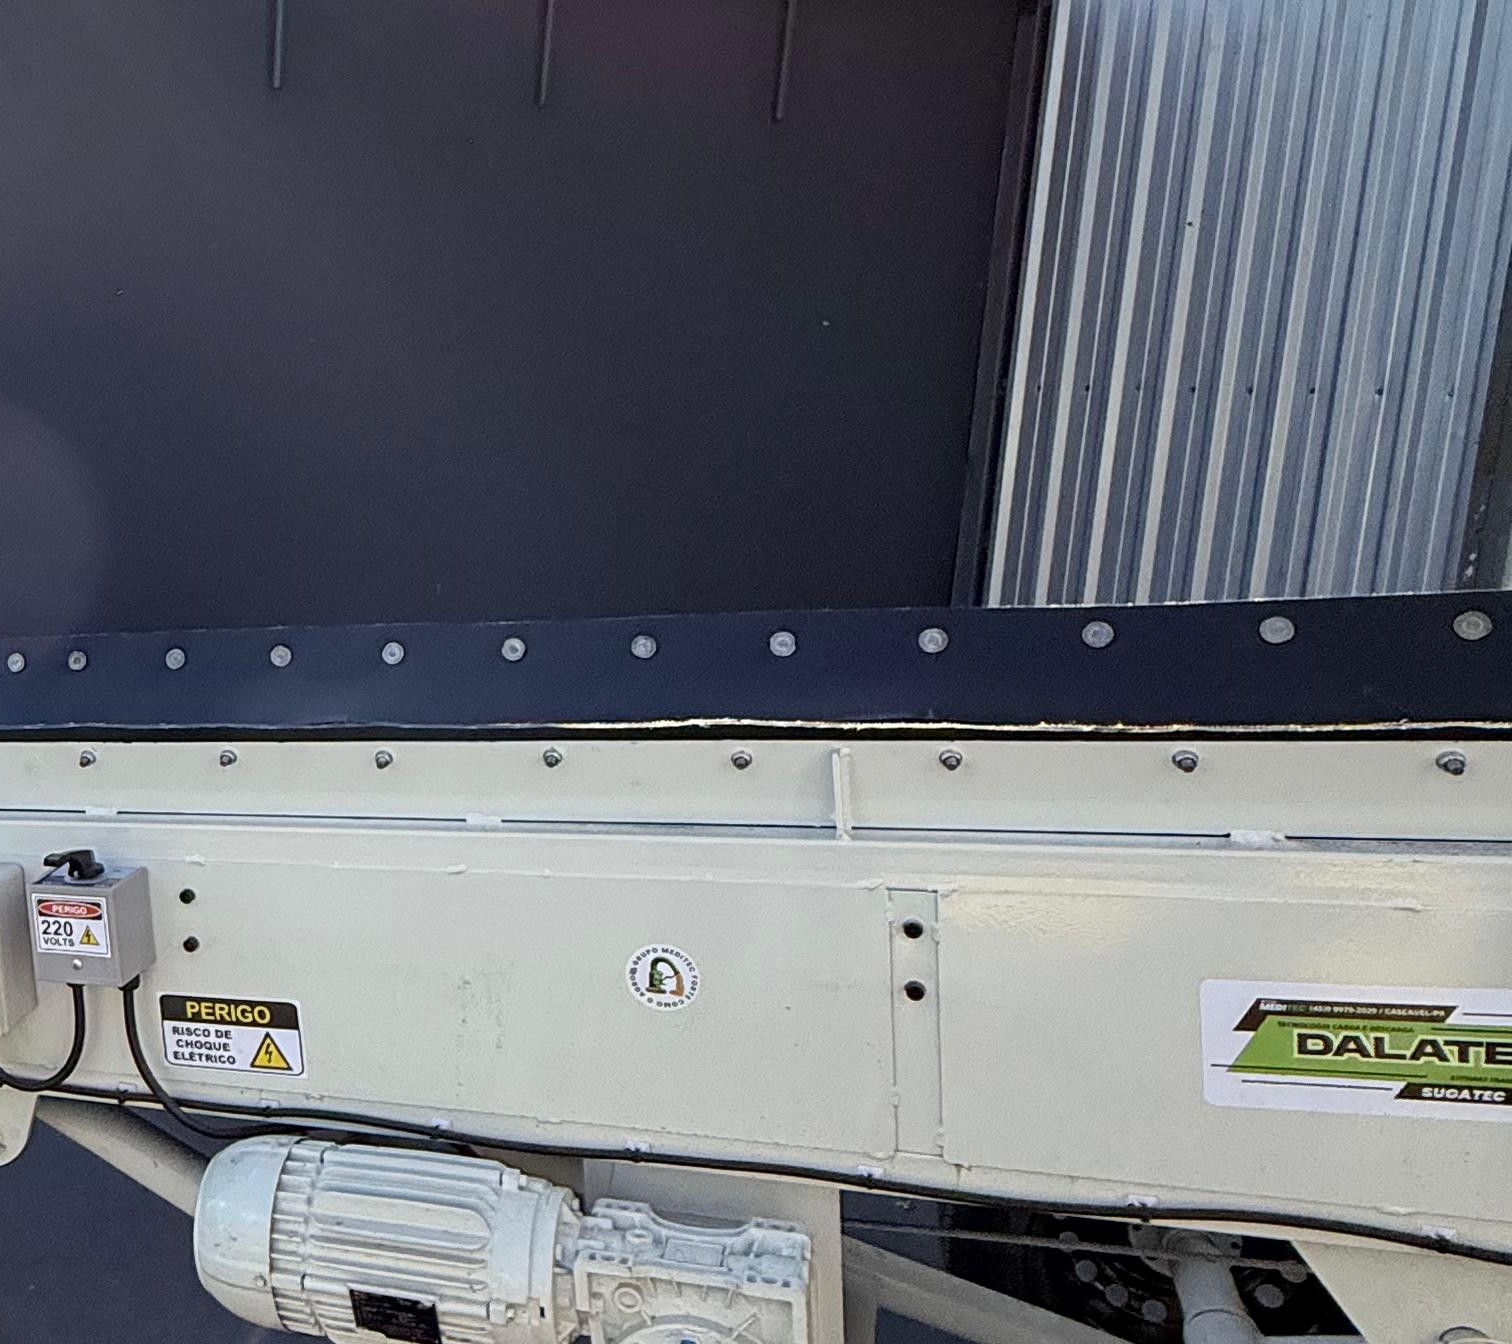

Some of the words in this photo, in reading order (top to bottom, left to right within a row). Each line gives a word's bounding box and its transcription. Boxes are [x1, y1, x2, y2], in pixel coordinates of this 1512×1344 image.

[51, 904, 87, 915] PERIGO
[41, 920, 73, 937] 220
[43, 937, 75, 947] VOLTS
[632, 947, 658, 966] GRUPO
[661, 947, 696, 973] MEDITEC
[656, 999, 685, 1008] COMO
[185, 1001, 271, 1024] PERIGO
[172, 1026, 211, 1038] RISCO
[215, 1029, 232, 1039] DE
[176, 1039, 231, 1052] CHOQUE
[173, 1051, 236, 1065] ELÉTRICO
